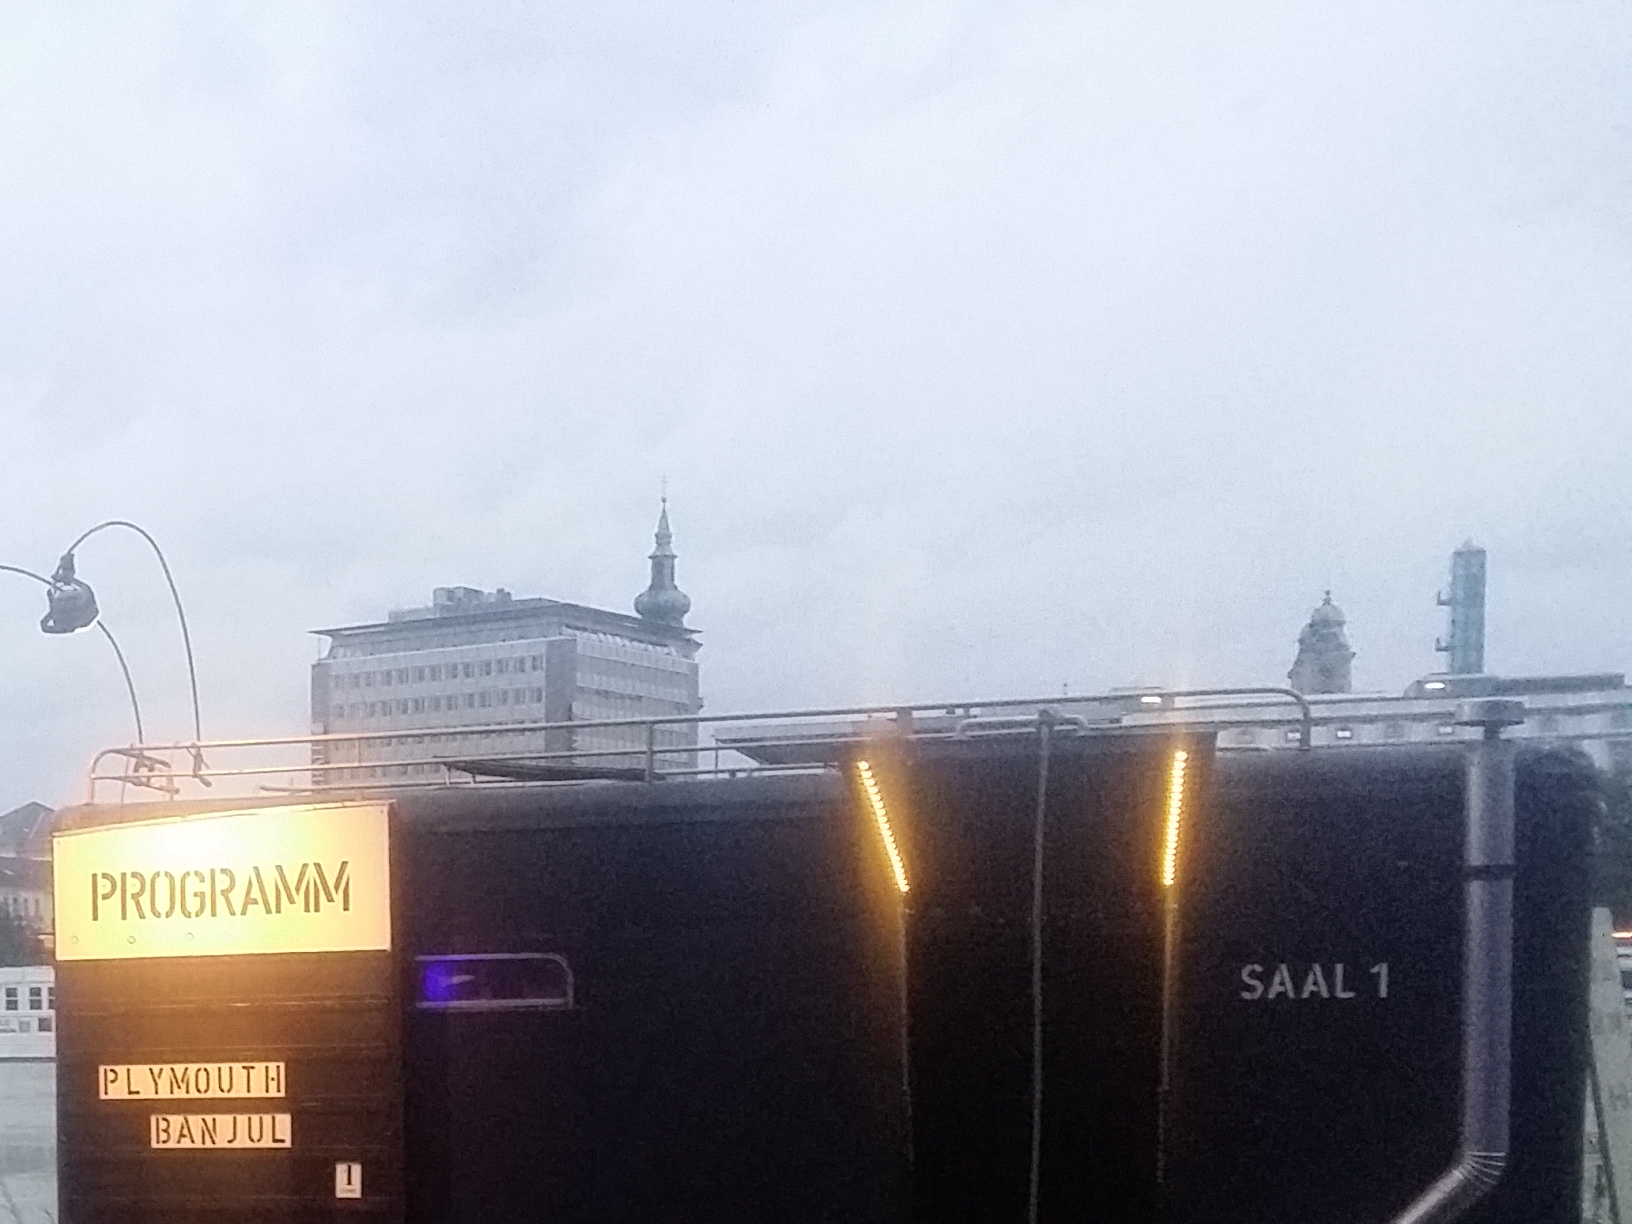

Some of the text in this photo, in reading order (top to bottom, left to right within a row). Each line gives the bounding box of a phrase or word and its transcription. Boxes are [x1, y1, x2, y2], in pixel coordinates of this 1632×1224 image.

[91, 860, 351, 922] PROGRAMM
[1240, 962, 1389, 1000] SAAL 1
[103, 1065, 281, 1096] PLYMOUTH
[155, 1115, 287, 1146] BANJUL
